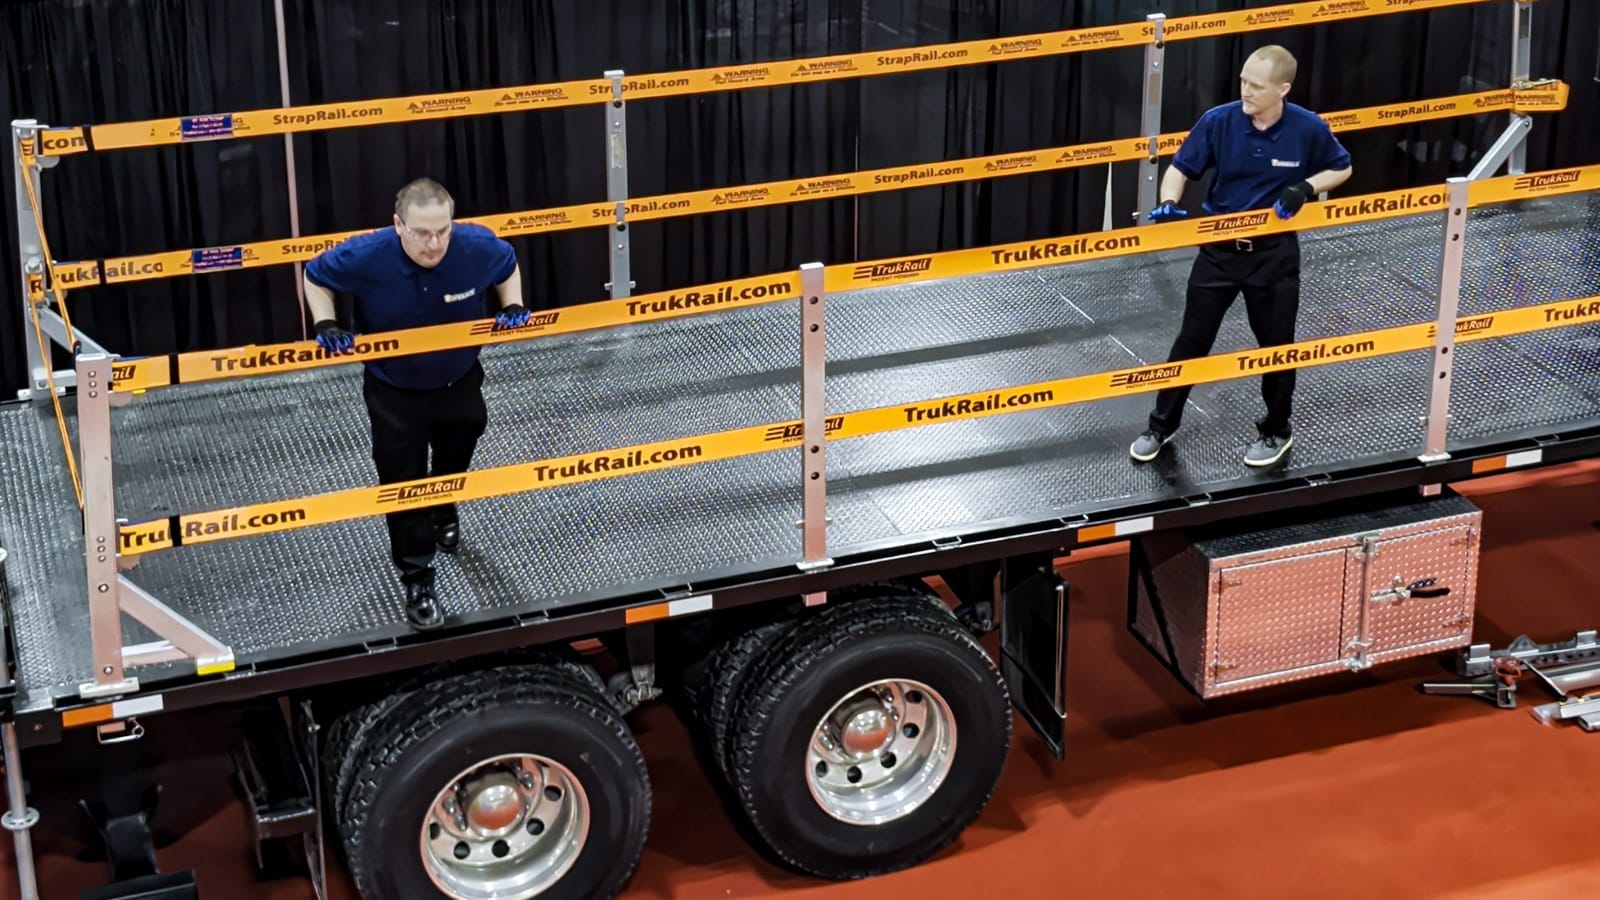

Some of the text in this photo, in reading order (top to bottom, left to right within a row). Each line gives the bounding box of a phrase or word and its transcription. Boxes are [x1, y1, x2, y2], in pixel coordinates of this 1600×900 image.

[876, 47, 968, 67] StrapRail.com
[723, 67, 769, 79] WARNING
[421, 95, 471, 108] WARNING
[513, 87, 563, 101] WARNING
[273, 105, 384, 127] StrapRail.com
[1377, 101, 1456, 120] StrapRail.com
[874, 165, 964, 185] StrapRail.com
[1533, 172, 1577, 187] TrukRail
[724, 187, 769, 199] WARNING
[519, 211, 566, 223] WARNING
[1218, 214, 1266, 230] TrukRail
[992, 234, 1140, 265] TrukRail.com
[876, 259, 928, 275] TrukRail
[626, 281, 791, 316] TrukRail.com
[1238, 339, 1375, 371] TrukRail.com
[1131, 366, 1178, 383] TrukRail
[904, 388, 1053, 423] TrukRail.com
[534, 445, 702, 482] TrukRail.com
[403, 478, 461, 498] TrukRail
[119, 508, 306, 549] TruRail.com
